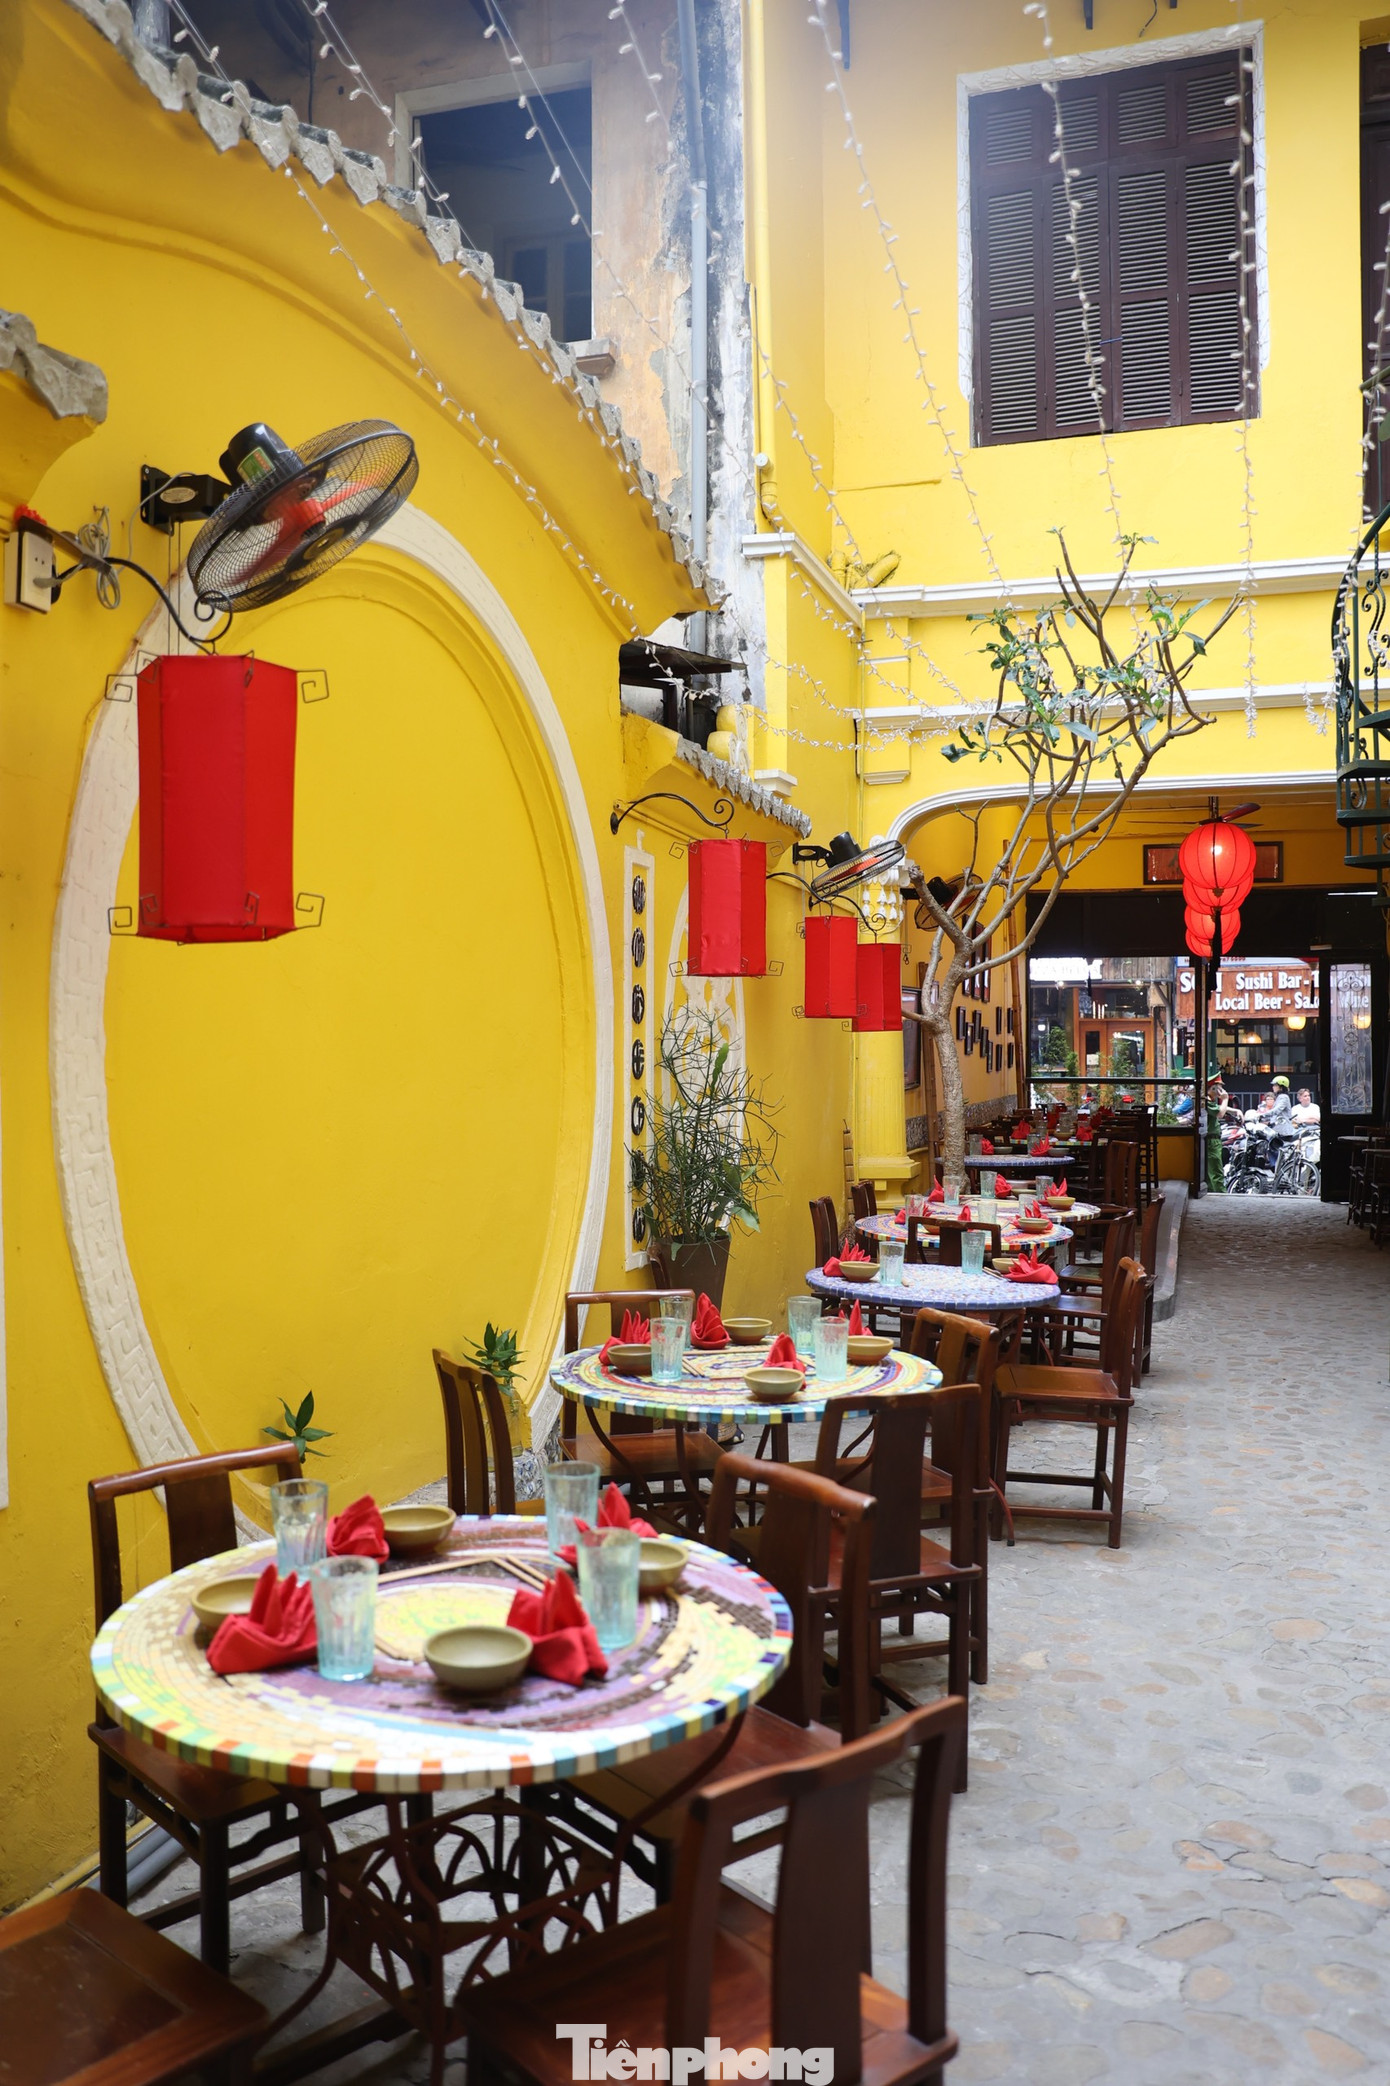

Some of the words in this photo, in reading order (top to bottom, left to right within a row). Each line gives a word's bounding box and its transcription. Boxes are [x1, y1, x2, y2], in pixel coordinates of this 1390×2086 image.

[1236, 972, 1273, 990] Sushi
[1278, 971, 1302, 989] Bar
[1215, 992, 1249, 1010] Local
[1254, 992, 1283, 1010] Beer
